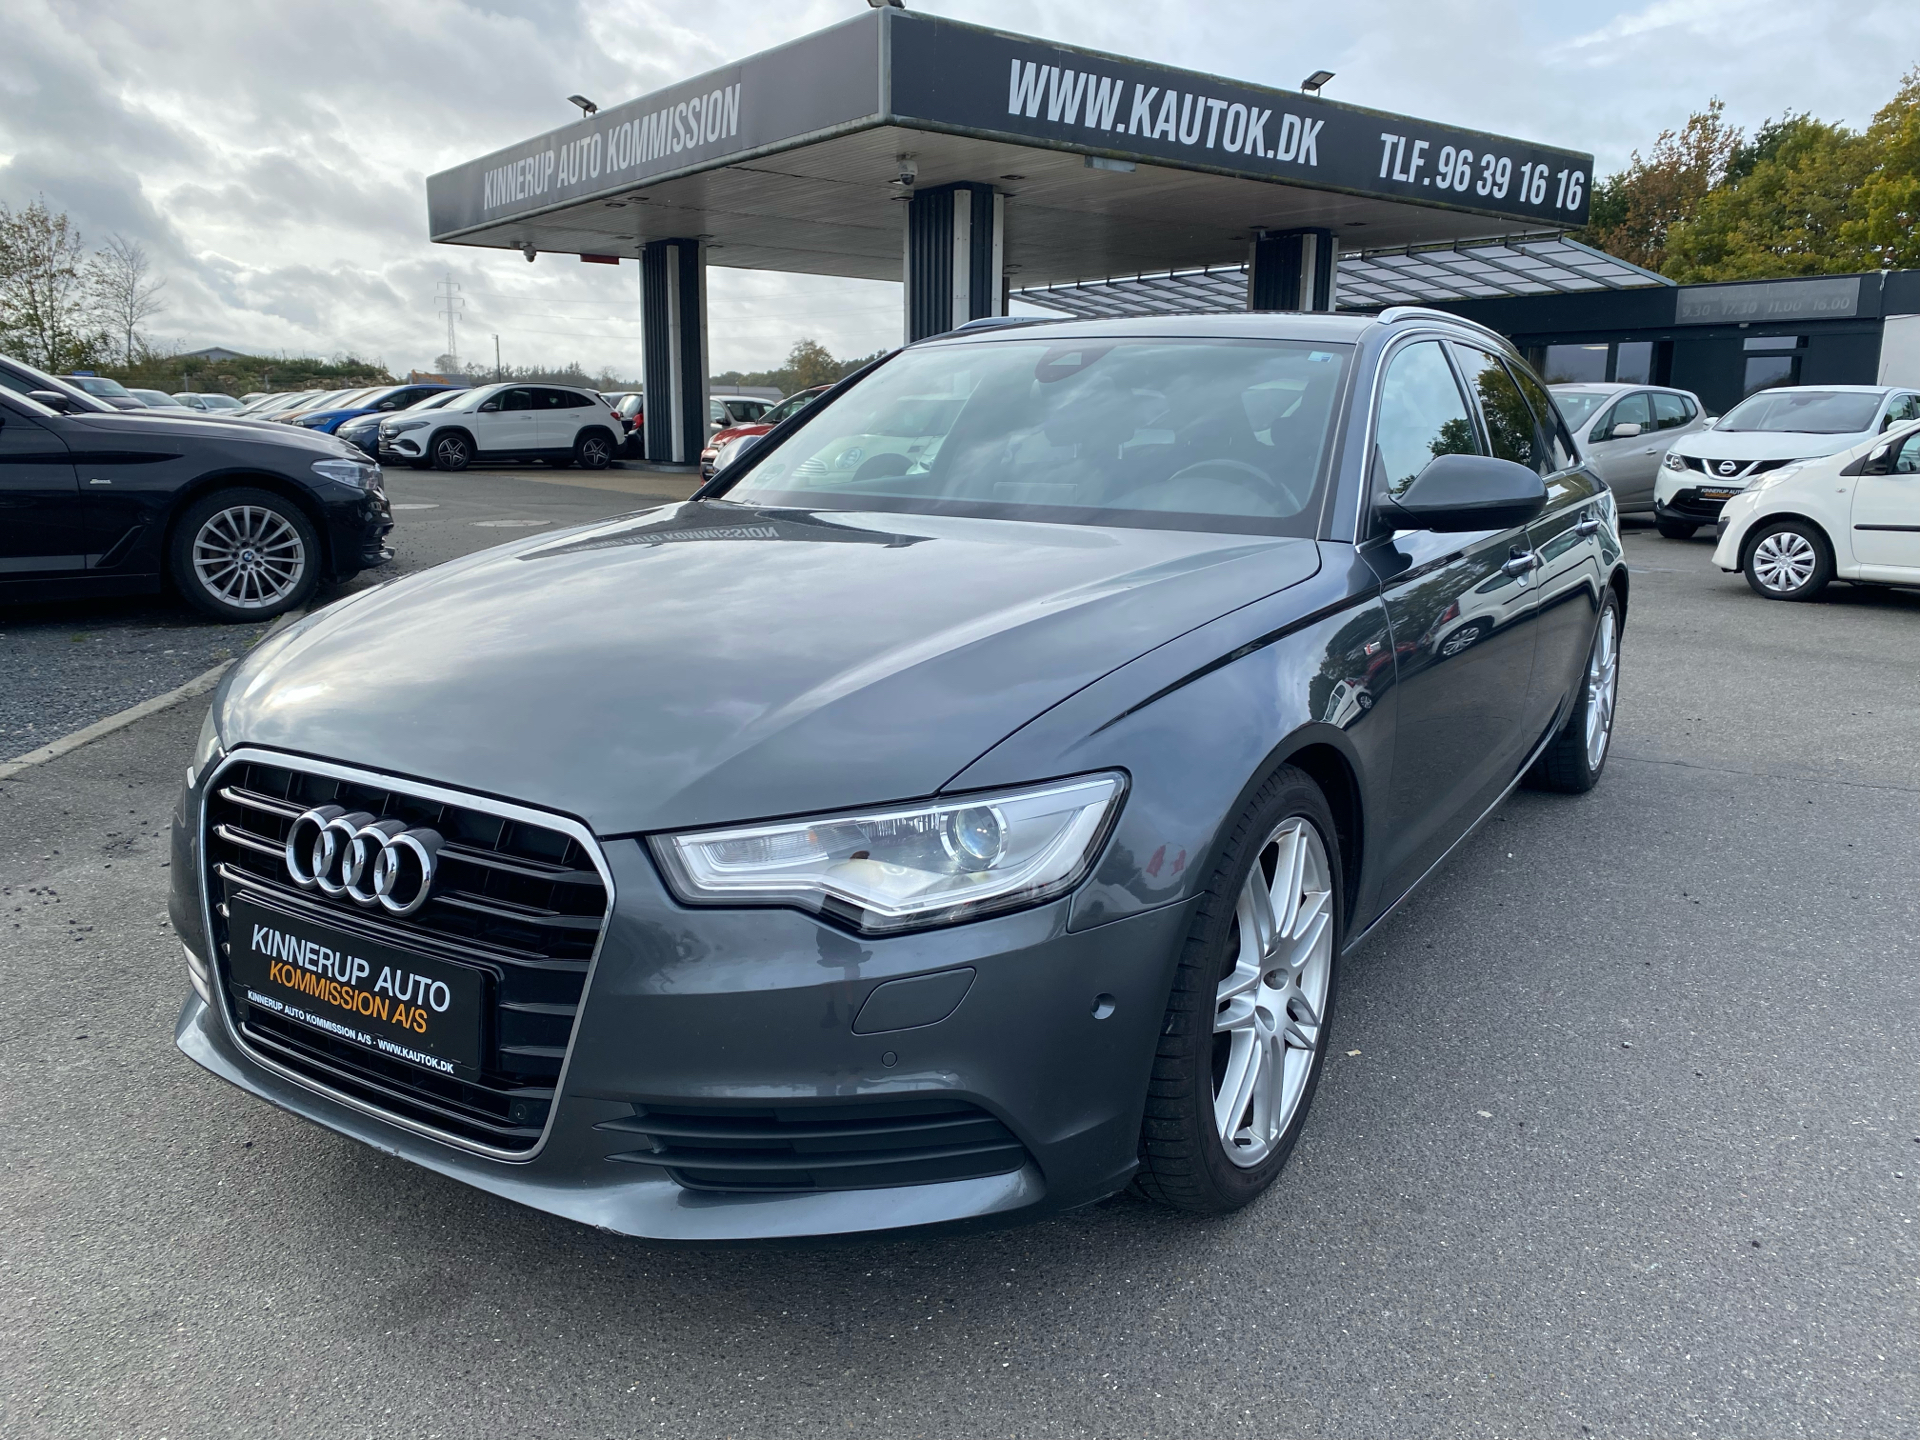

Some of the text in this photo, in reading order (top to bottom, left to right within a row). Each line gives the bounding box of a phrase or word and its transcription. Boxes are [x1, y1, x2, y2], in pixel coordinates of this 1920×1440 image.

[484, 83, 741, 210] KINNERUP AUTO KOMMISSION
[1008, 58, 1325, 167] WWW.KAUTOK.DK
[1379, 132, 1585, 211] TLF. 96 39 16 16
[251, 924, 450, 1012] KINNERUP AUTO
[269, 960, 428, 1034] KOMMISSION A/S
[247, 990, 283, 1011] KINNERUP
[284, 1004, 305, 1021] AUTO
[306, 1013, 356, 1040] KOMMISSION
[357, 1031, 372, 1046] A/S
[377, 1038, 455, 1075] WWW.KAUTOK.DK
